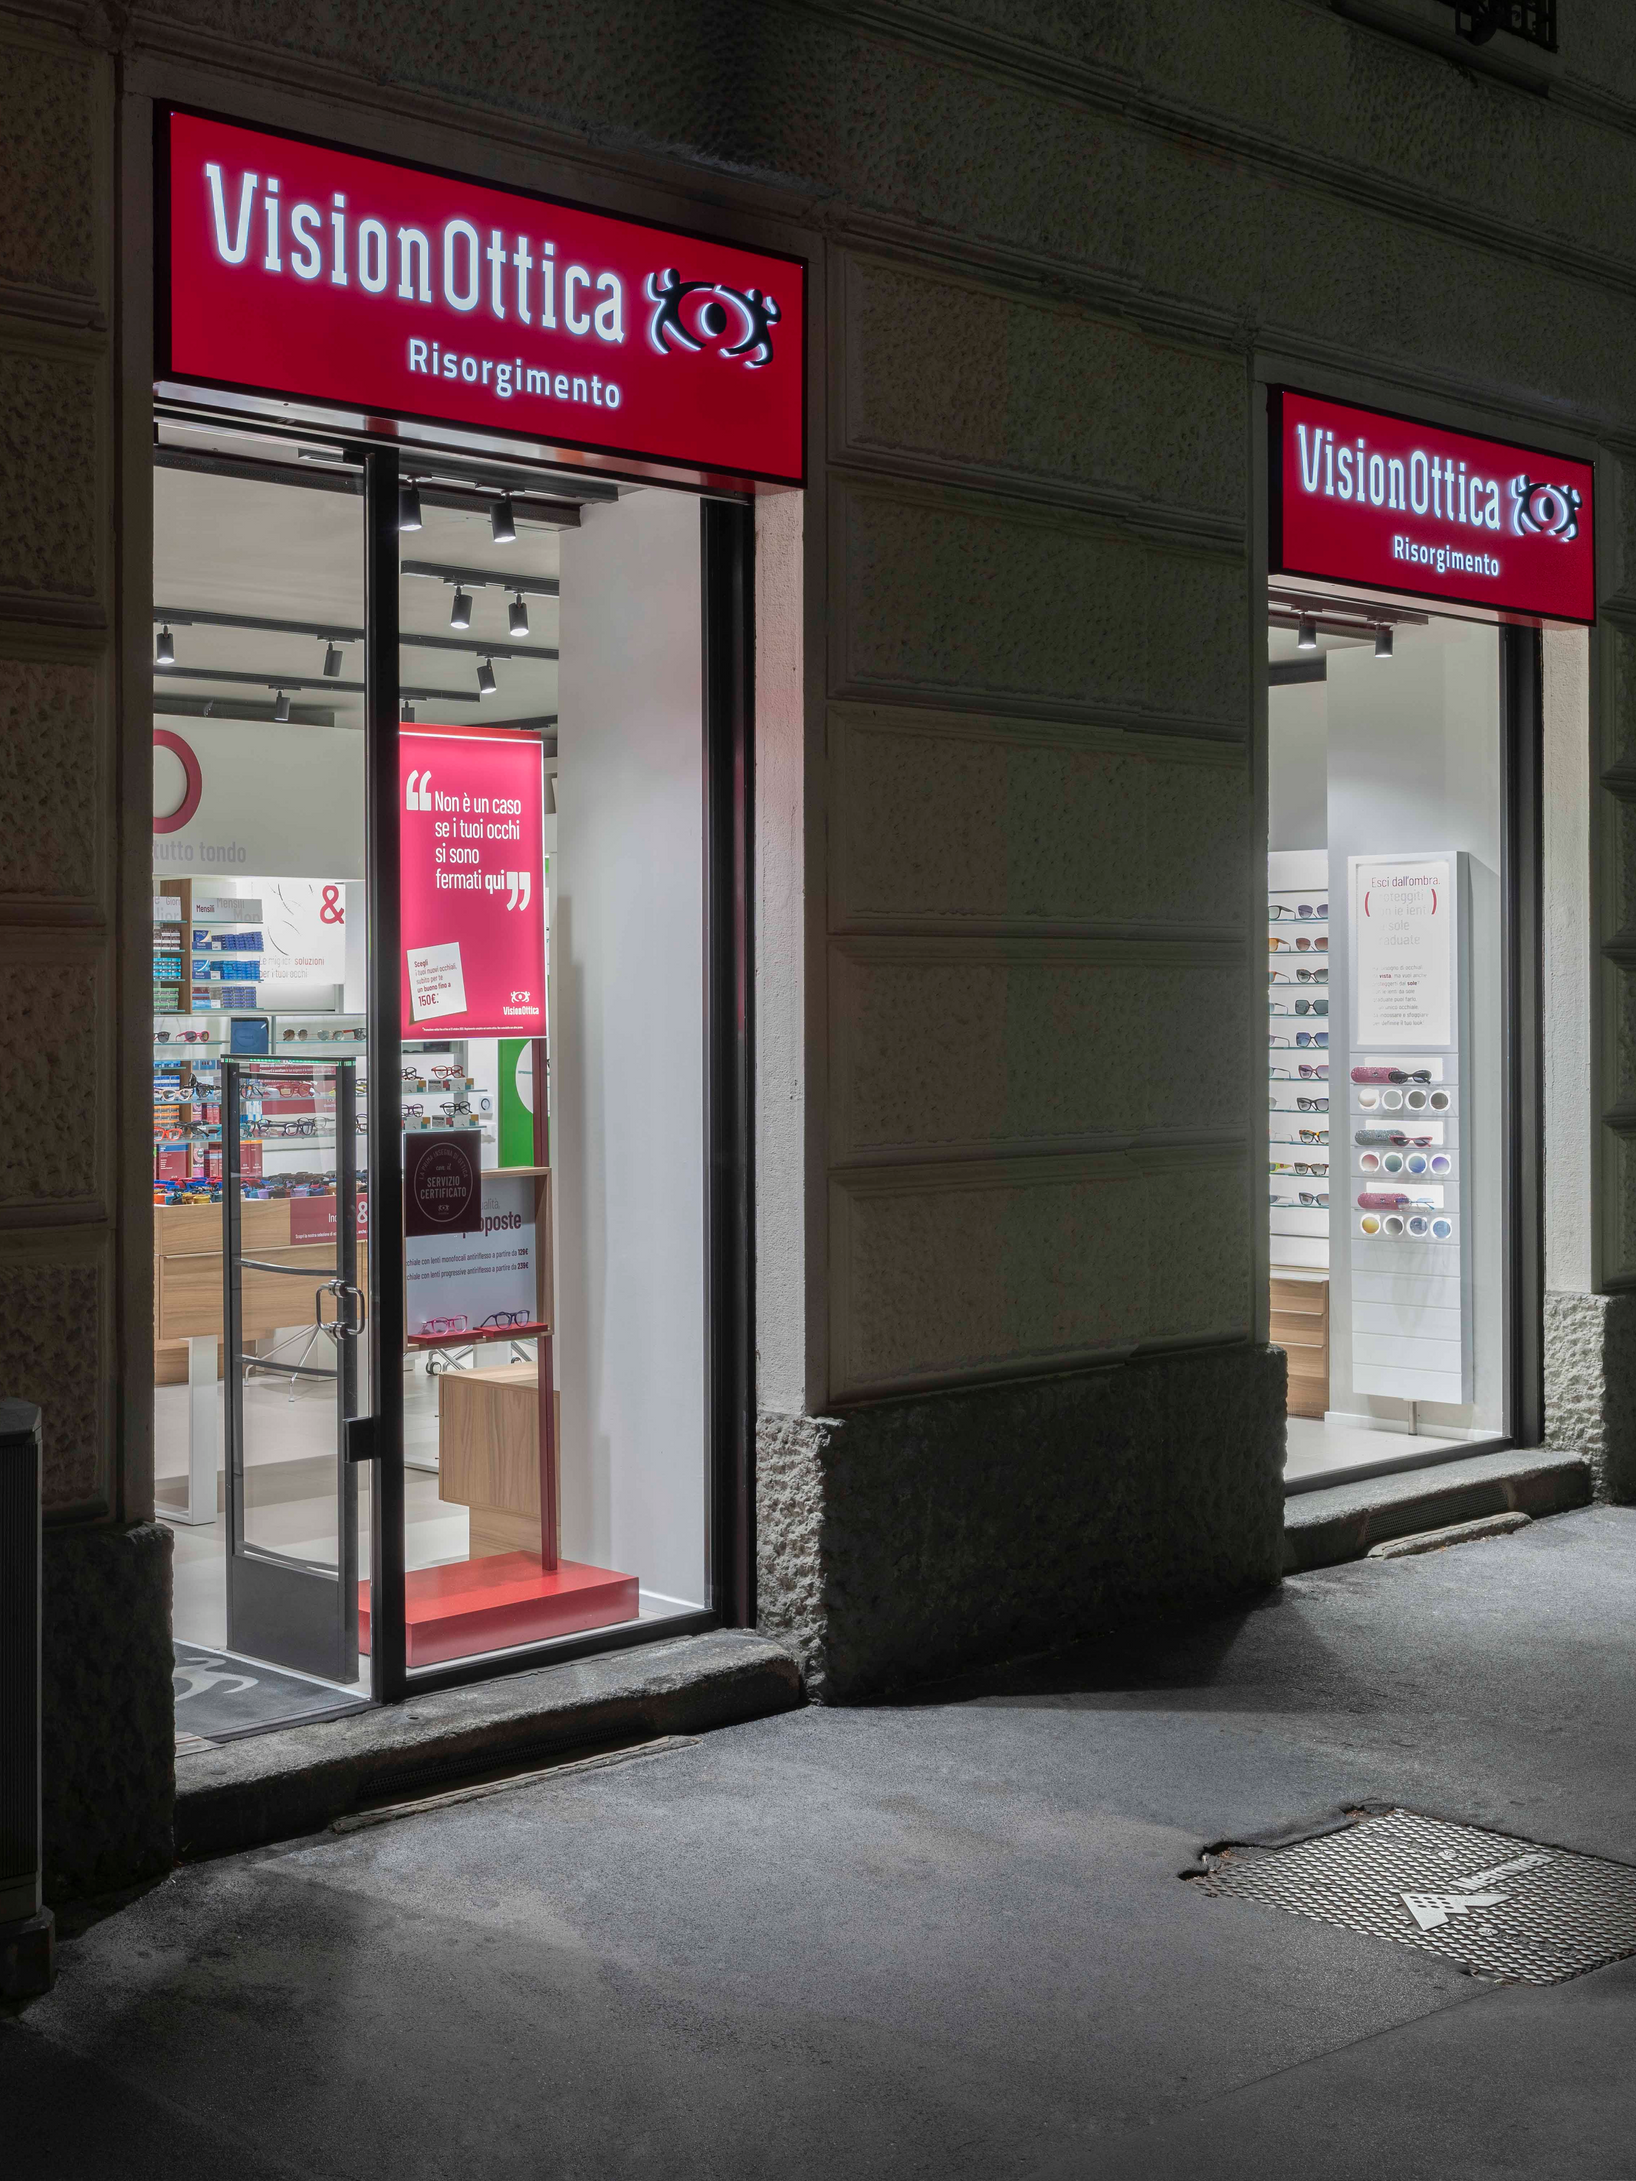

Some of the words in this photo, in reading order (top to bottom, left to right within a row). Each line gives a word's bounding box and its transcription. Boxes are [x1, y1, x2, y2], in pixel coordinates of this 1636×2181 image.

[205, 162, 626, 344] VisionOttica
[408, 337, 622, 410] Risorgimento
[1297, 423, 1501, 531] VisionOttica
[1393, 534, 1500, 578] Risorgimento
[435, 790, 460, 812] Non
[462, 792, 471, 813] è
[473, 797, 489, 813] un
[492, 798, 522, 815] caso
[435, 821, 450, 837] se
[452, 817, 457, 838] i
[459, 818, 484, 839] tuoi
[487, 819, 520, 840] occhi
[154, 840, 194, 861] tutto
[199, 841, 247, 863] tondo
[435, 842, 446, 863] si
[449, 848, 480, 864] sono
[435, 868, 482, 890] fermati
[485, 869, 505, 895] qui
[1371, 877, 1390, 888] Esci
[196, 904, 215, 913] Mensili
[1388, 919, 1410, 931] sole
[294, 957, 325, 966] soluzioni
[414, 959, 428, 968] Scegli
[424, 984, 437, 992] buono
[503, 1005, 540, 1016] VisionOttica
[427, 1175, 460, 1188] SERVIZIO
[420, 1186, 467, 1200] CERTIFICATO
[421, 1257, 430, 1265] con
[430, 1256, 441, 1264] lenti
[441, 1254, 467, 1263] monofocali
[496, 1249, 511, 1260] partire
[511, 1249, 517, 1257] da
[421, 1271, 430, 1279] con
[430, 1270, 440, 1278] lenti
[441, 1268, 467, 1278] progressive
[495, 1263, 511, 1274] partire
[1449, 1853, 1556, 1892] Metroweb
